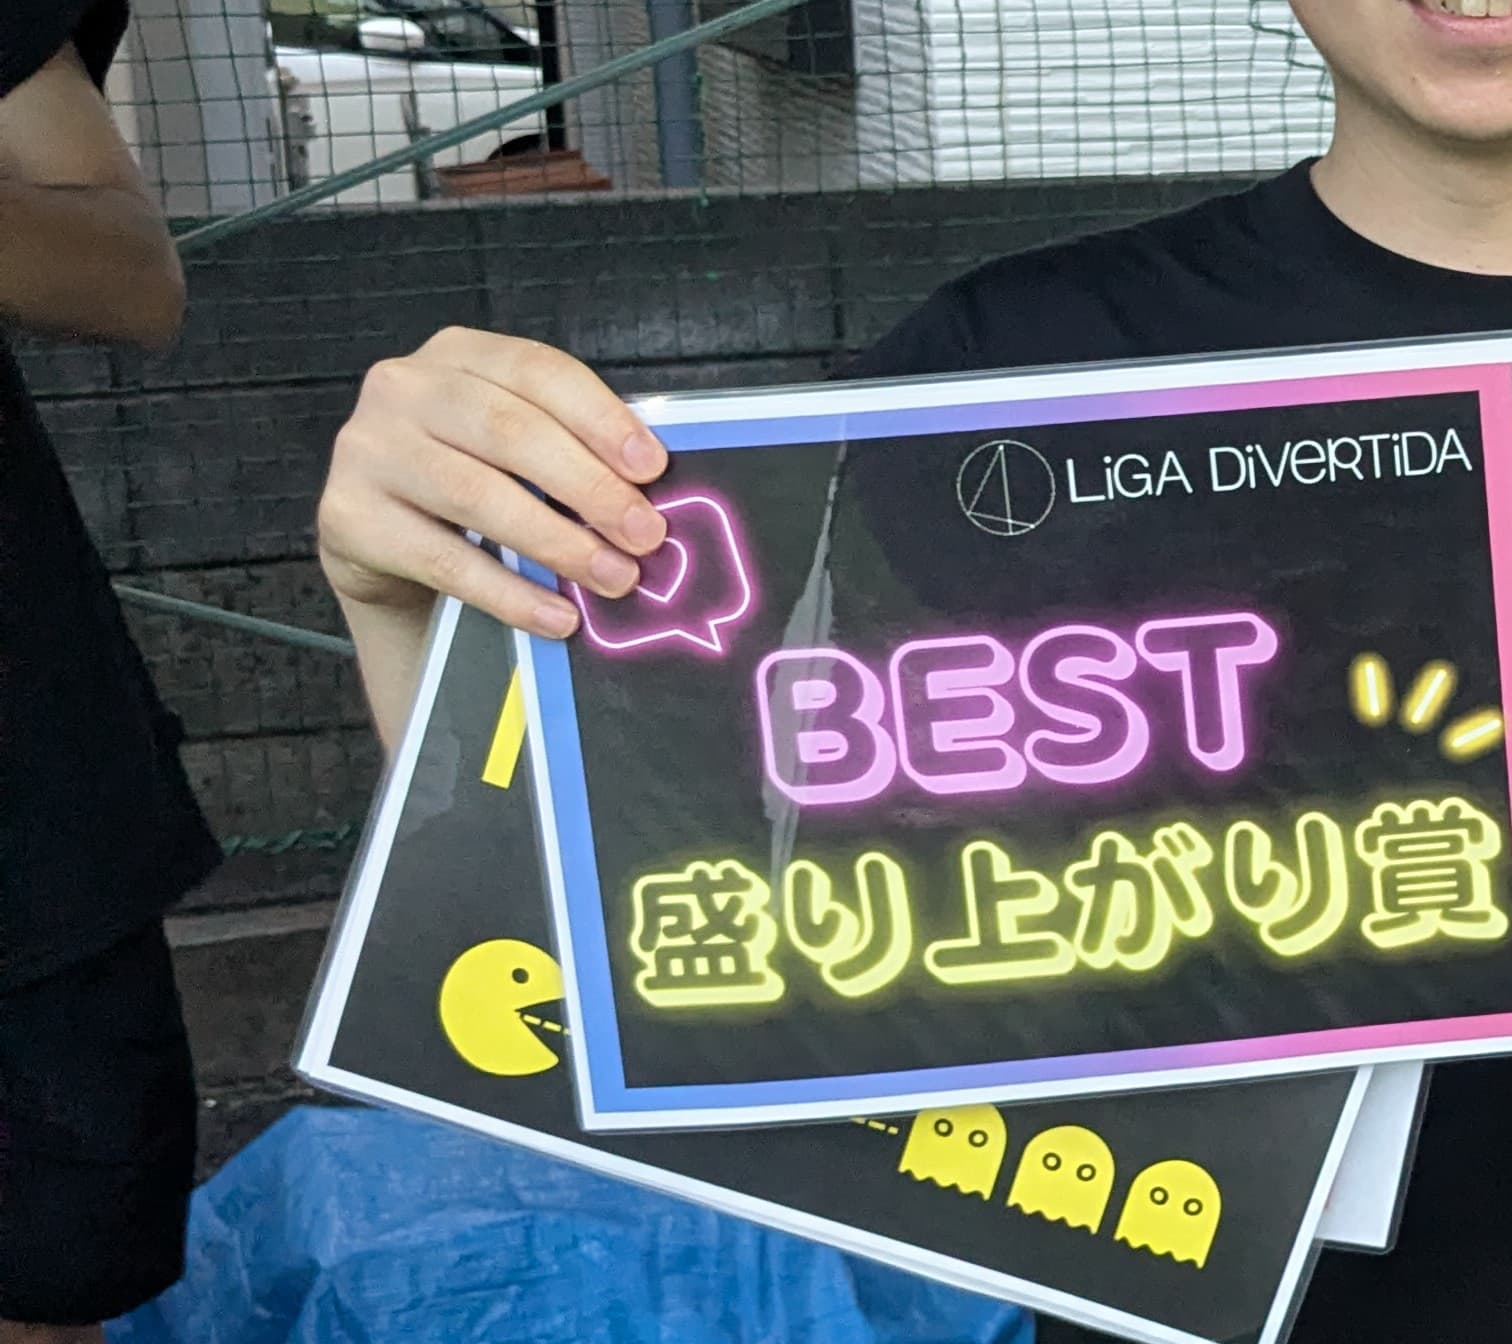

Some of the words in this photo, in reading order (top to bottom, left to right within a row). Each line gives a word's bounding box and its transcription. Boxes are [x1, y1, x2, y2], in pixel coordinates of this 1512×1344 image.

[1065, 450, 1193, 503] LiGA
[756, 612, 1279, 806] BEST
[630, 796, 1510, 1008] 盛り上がり賞
